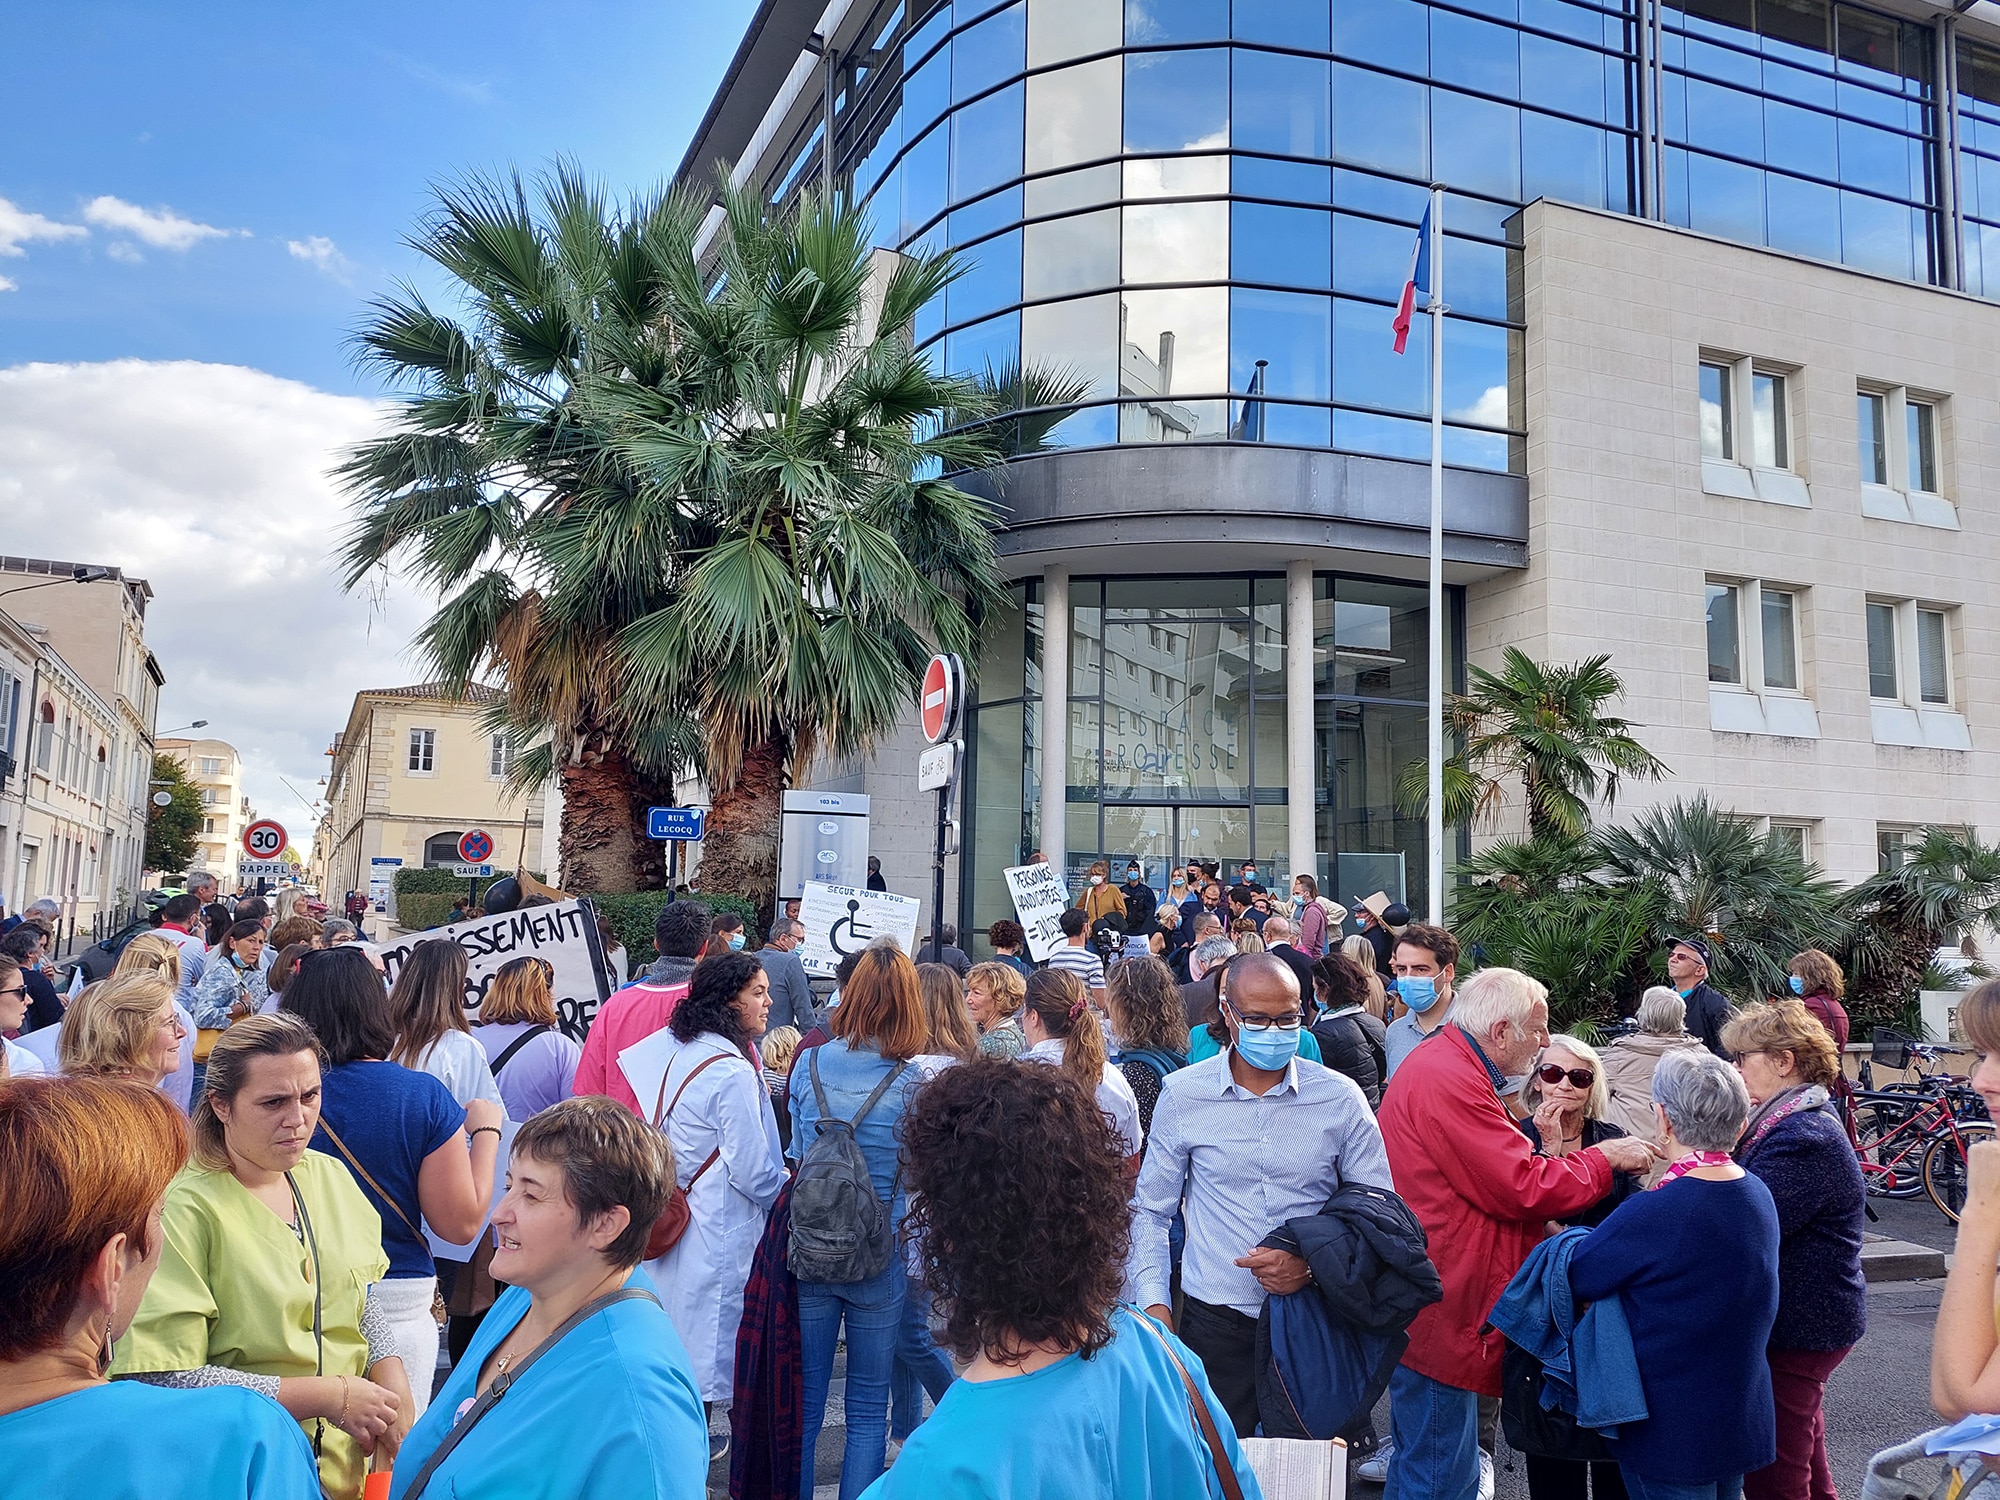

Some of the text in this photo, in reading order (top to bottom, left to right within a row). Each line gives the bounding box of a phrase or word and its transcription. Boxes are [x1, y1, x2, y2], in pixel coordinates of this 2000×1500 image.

[1117, 710, 1235, 736] ESPACE
[1117, 743, 1235, 770] RODESSE
[921, 762, 934, 778] SAUF
[667, 814, 685, 822] RUE
[658, 825, 693, 835] LECOCQ
[251, 831, 279, 849] 30
[239, 864, 287, 874] RAPPEL
[456, 867, 479, 875] SAUF
[1013, 864, 1053, 889] PERSONNES
[827, 885, 855, 896] SEGUR
[859, 890, 879, 900] POUR
[802, 957, 819, 968] CAR
